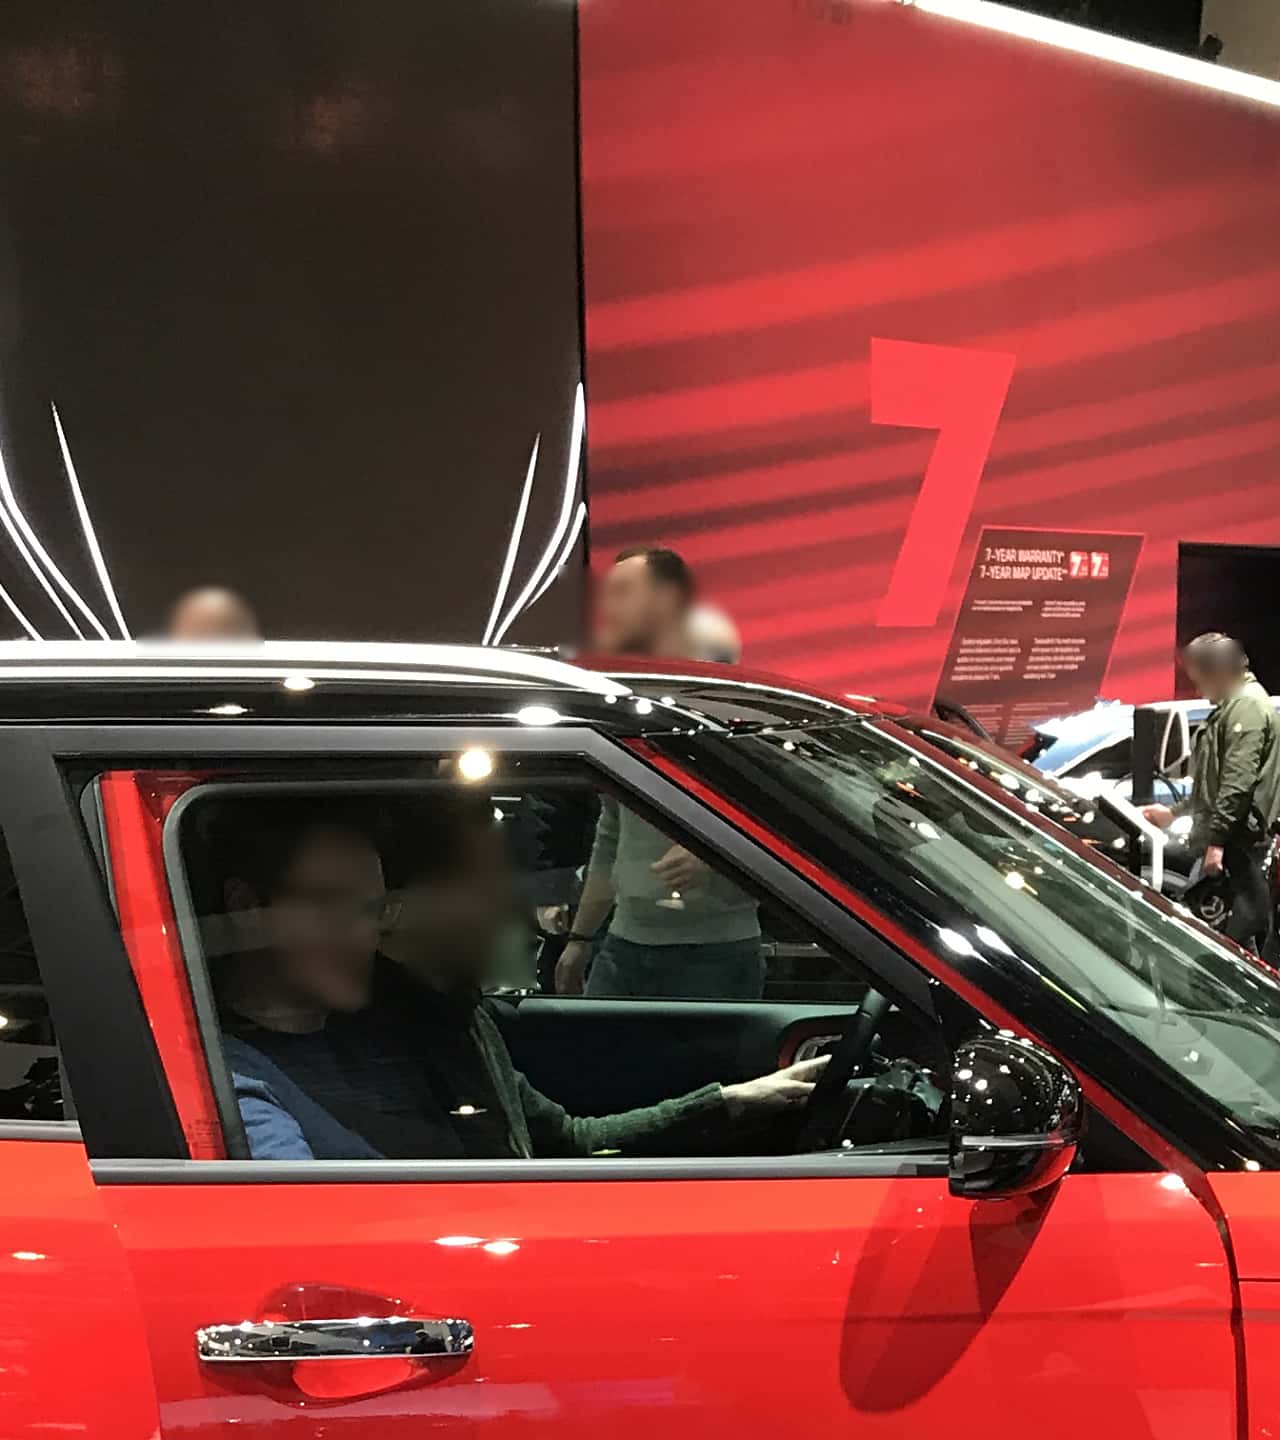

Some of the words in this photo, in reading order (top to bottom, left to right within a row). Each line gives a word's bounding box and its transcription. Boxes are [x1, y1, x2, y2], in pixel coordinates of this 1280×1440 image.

[871, 336, 1017, 627] 7
[985, 547, 1017, 562] 7-YEAR
[980, 564, 1012, 580] 7-YEAR
